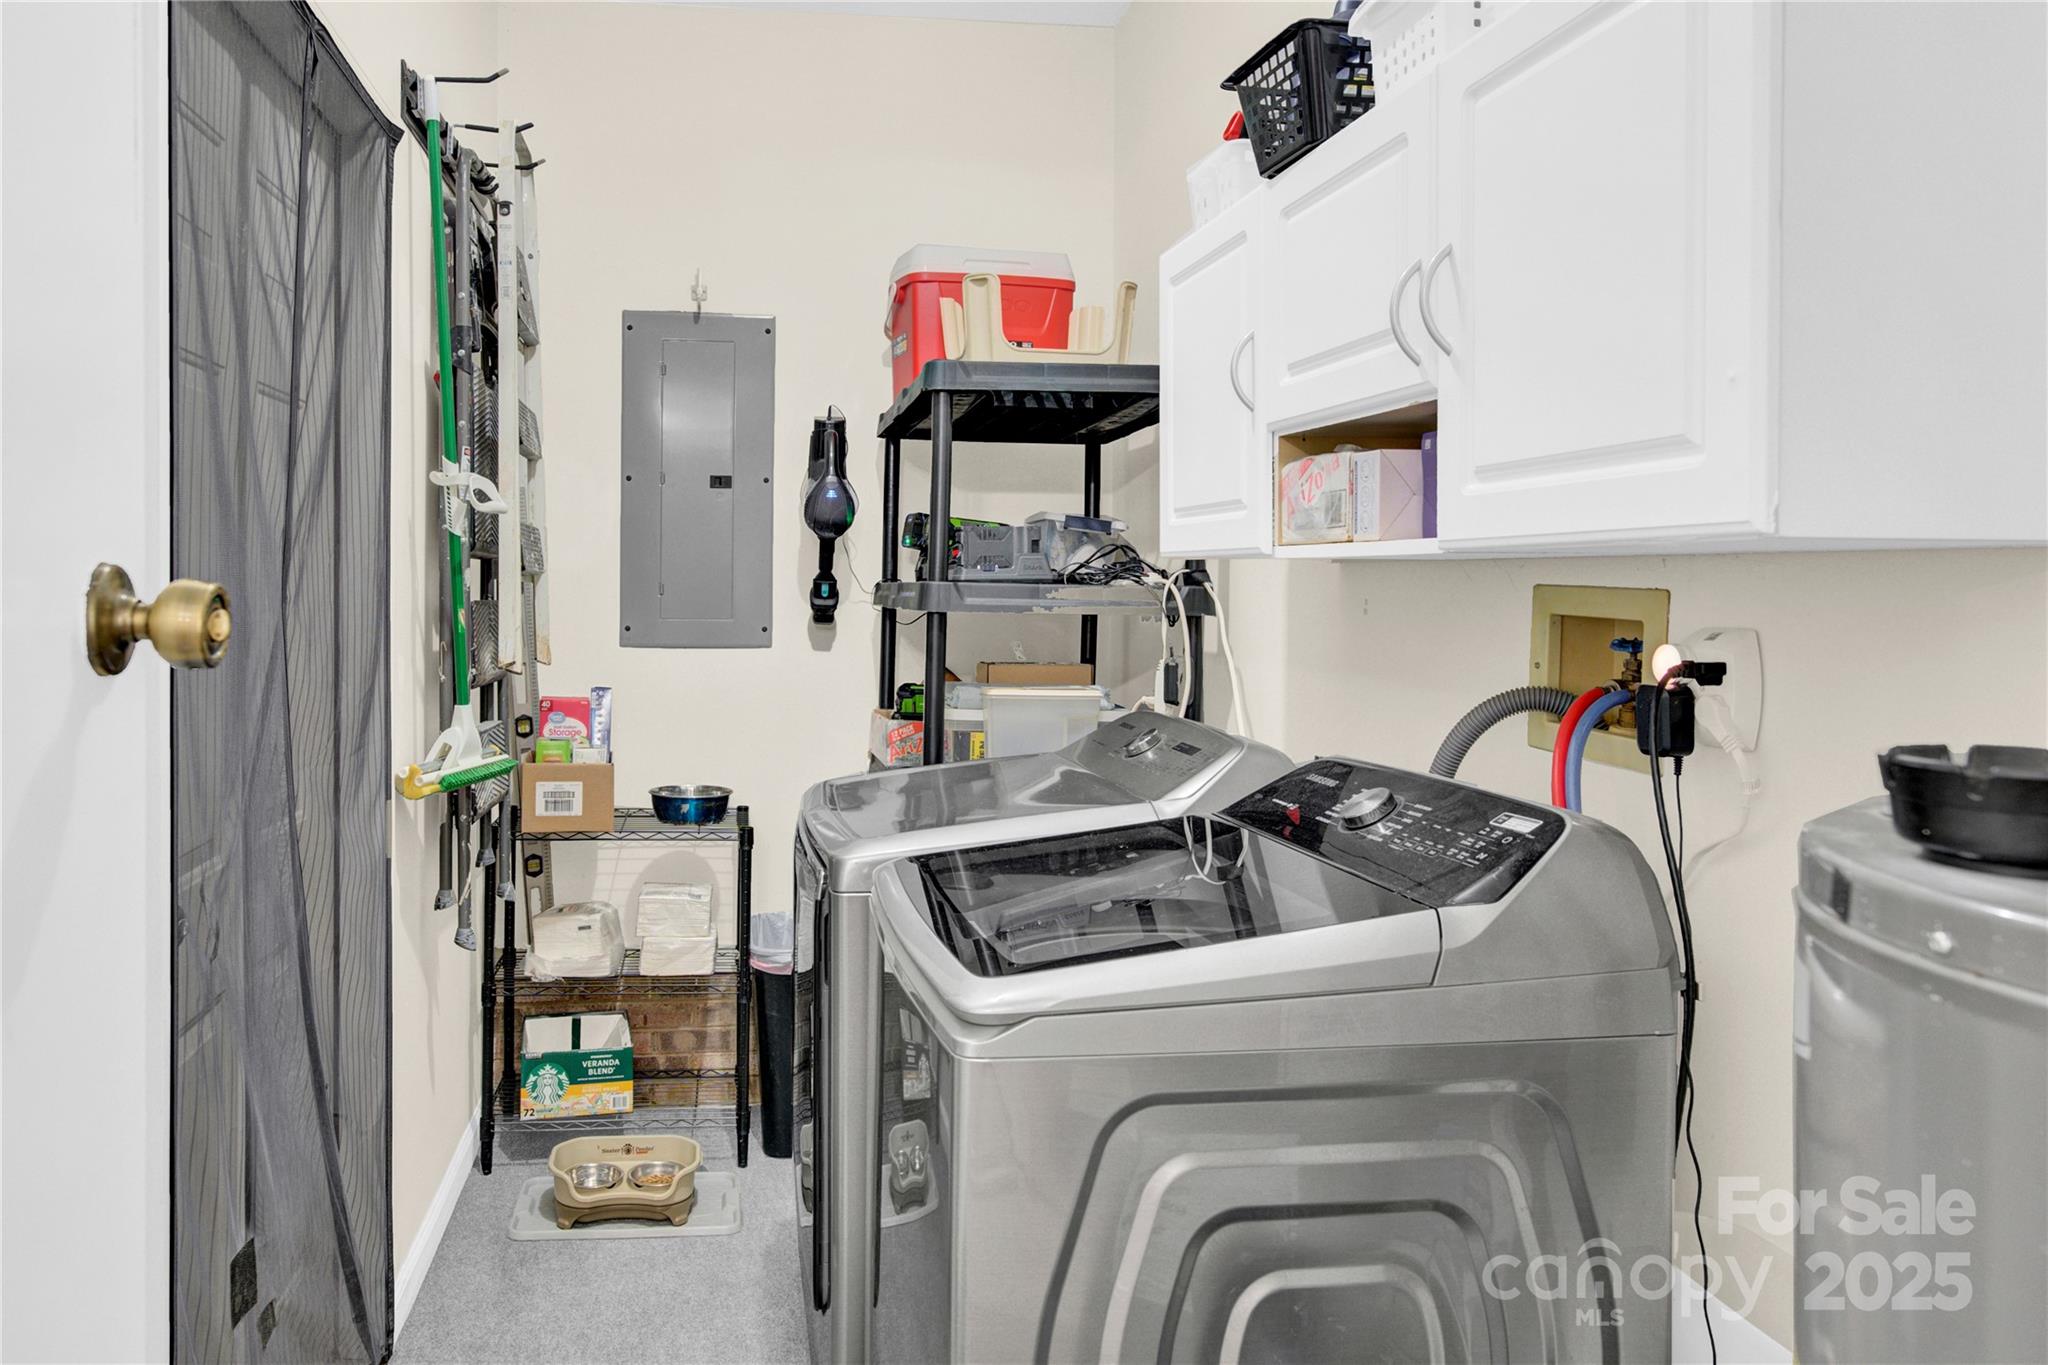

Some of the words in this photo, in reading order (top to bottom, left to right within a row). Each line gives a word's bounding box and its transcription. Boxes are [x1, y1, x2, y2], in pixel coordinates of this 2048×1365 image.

[541, 700, 551, 708] 40
[548, 728, 582, 737] Storage
[582, 1058, 620, 1068] VERANDA
[588, 1067, 613, 1076] BLEND
[523, 1108, 535, 1117] 72
